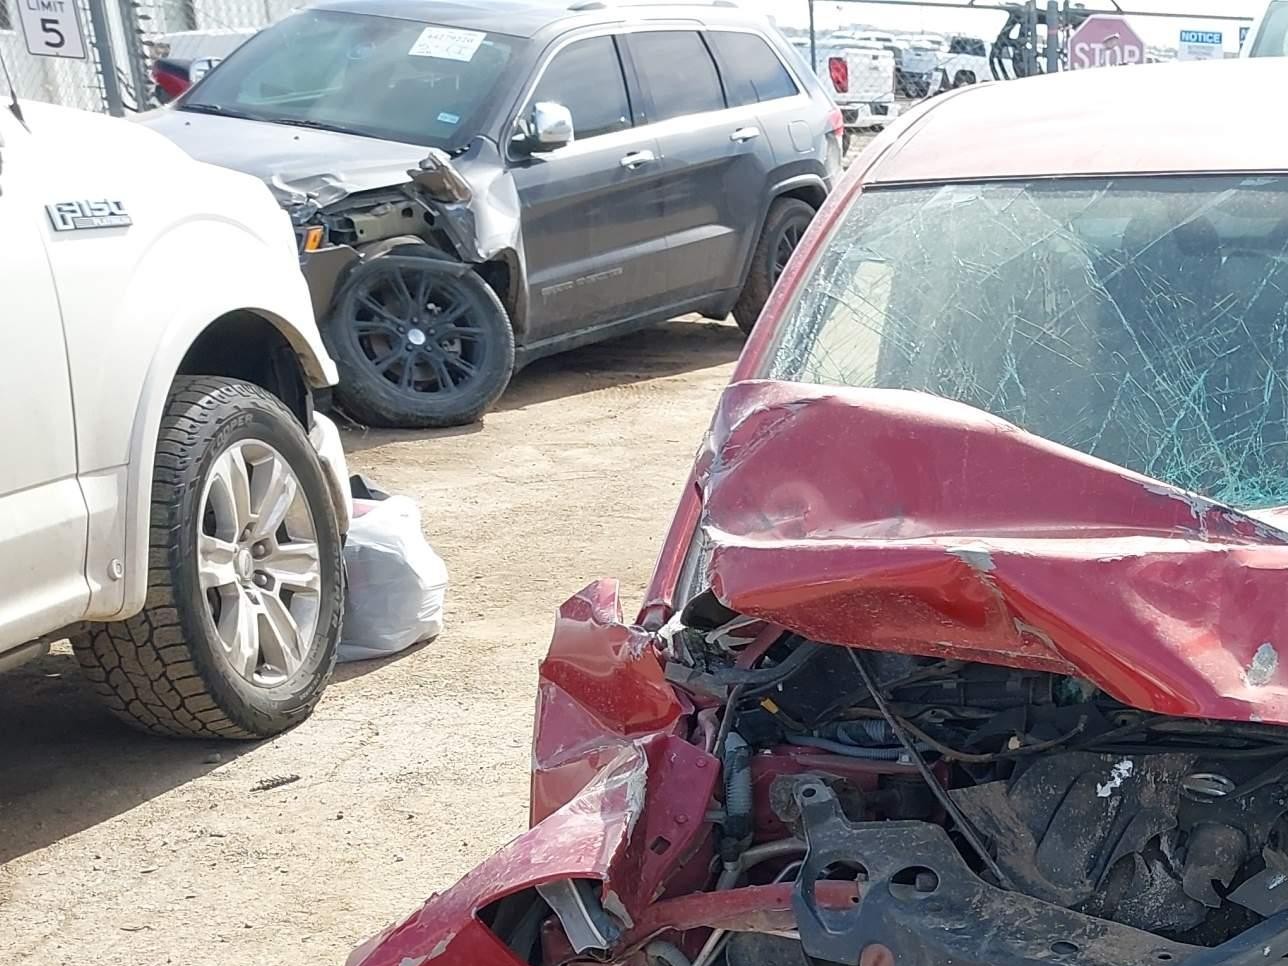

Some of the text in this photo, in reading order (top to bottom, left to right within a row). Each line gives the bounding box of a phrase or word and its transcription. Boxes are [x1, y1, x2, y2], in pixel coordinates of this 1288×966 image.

[40, 18, 65, 48] 5
[1181, 31, 1222, 44] NOTICE
[1074, 42, 1140, 70] STOP
[211, 413, 254, 457] COOPER
